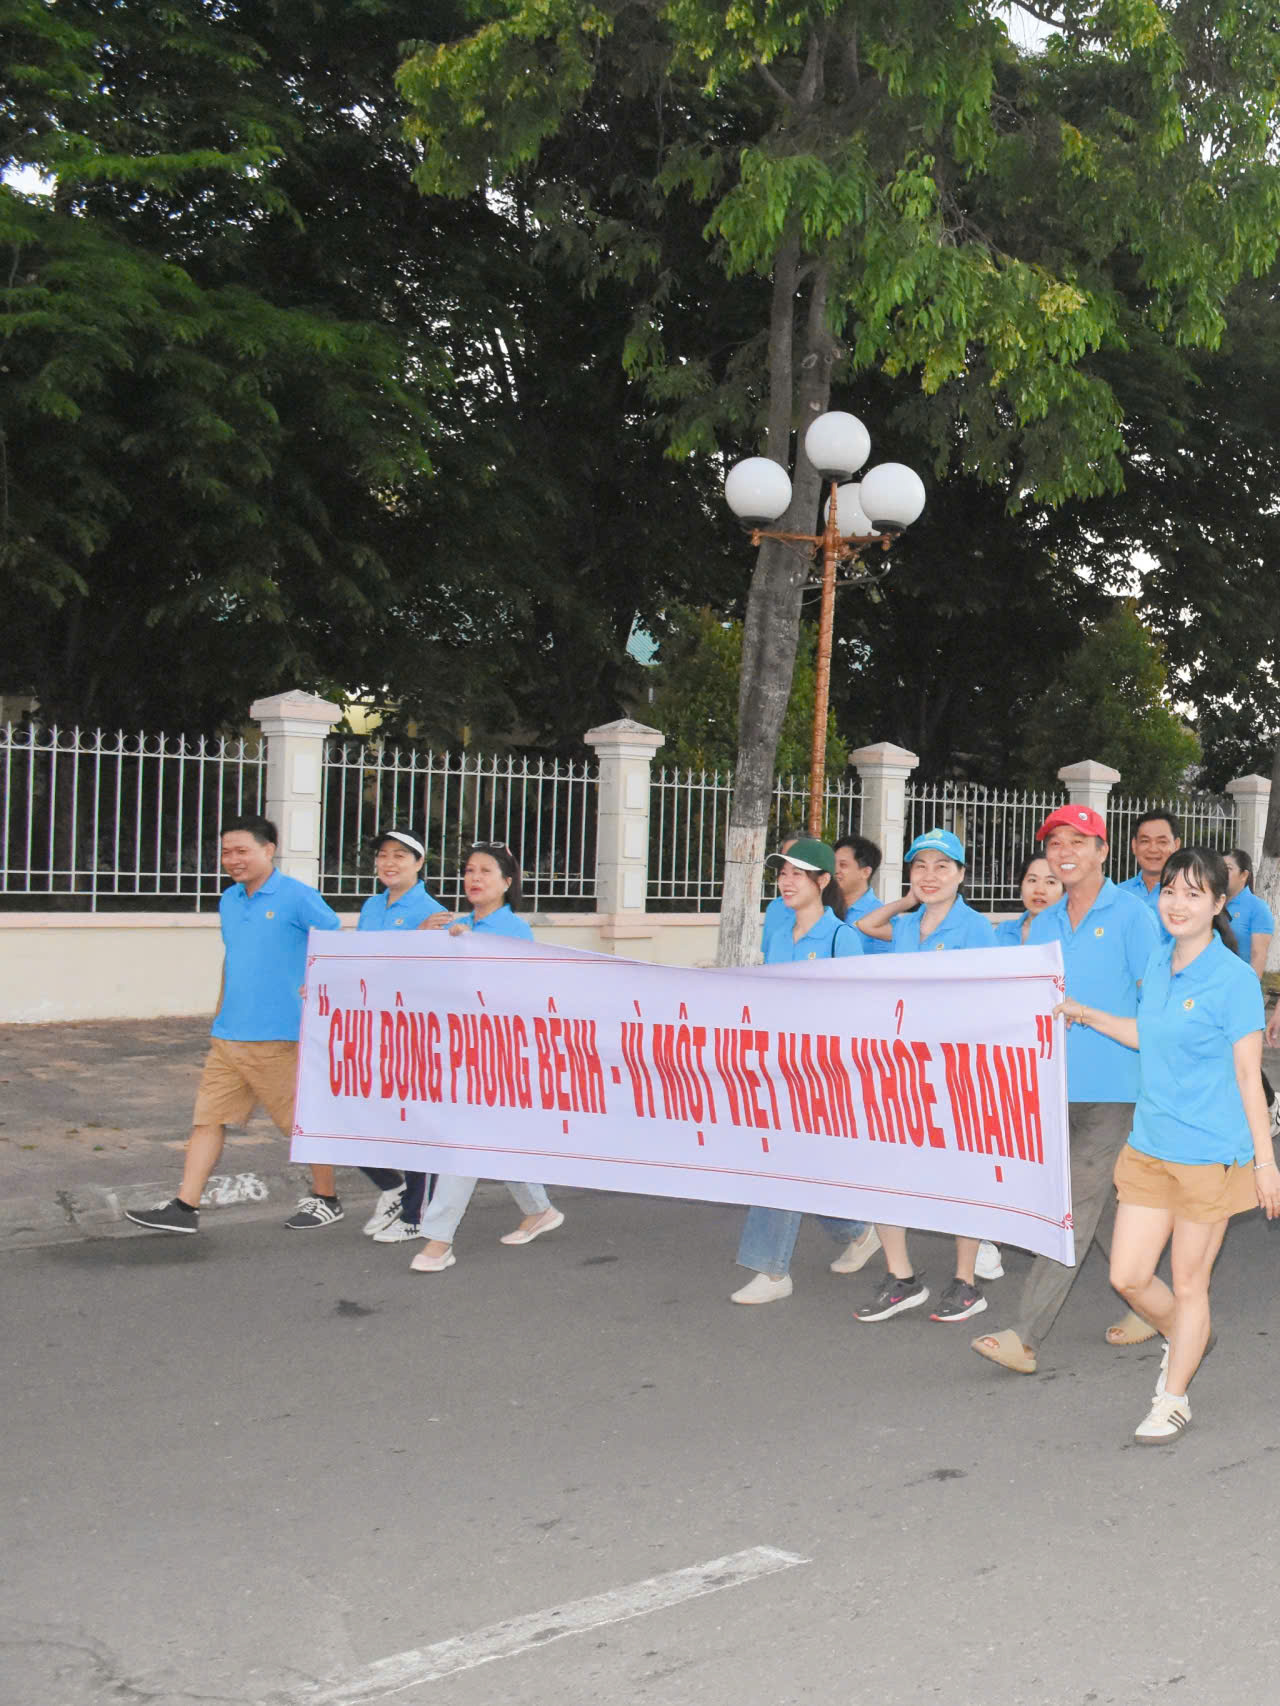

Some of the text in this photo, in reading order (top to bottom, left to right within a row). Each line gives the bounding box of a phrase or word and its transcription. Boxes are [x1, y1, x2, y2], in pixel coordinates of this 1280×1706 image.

[380, 992, 442, 1121] ĐỘNG
[448, 991, 532, 1109] PHÒNG
[533, 997, 606, 1134] BỆNH
[611, 1067, 621, 1084] -
[621, 1000, 655, 1118] VÌ
[653, 1002, 717, 1145] MỘT
[714, 1006, 781, 1152] VIỆT
[778, 1032, 858, 1139] NAM
[851, 999, 946, 1149] KHỎE
